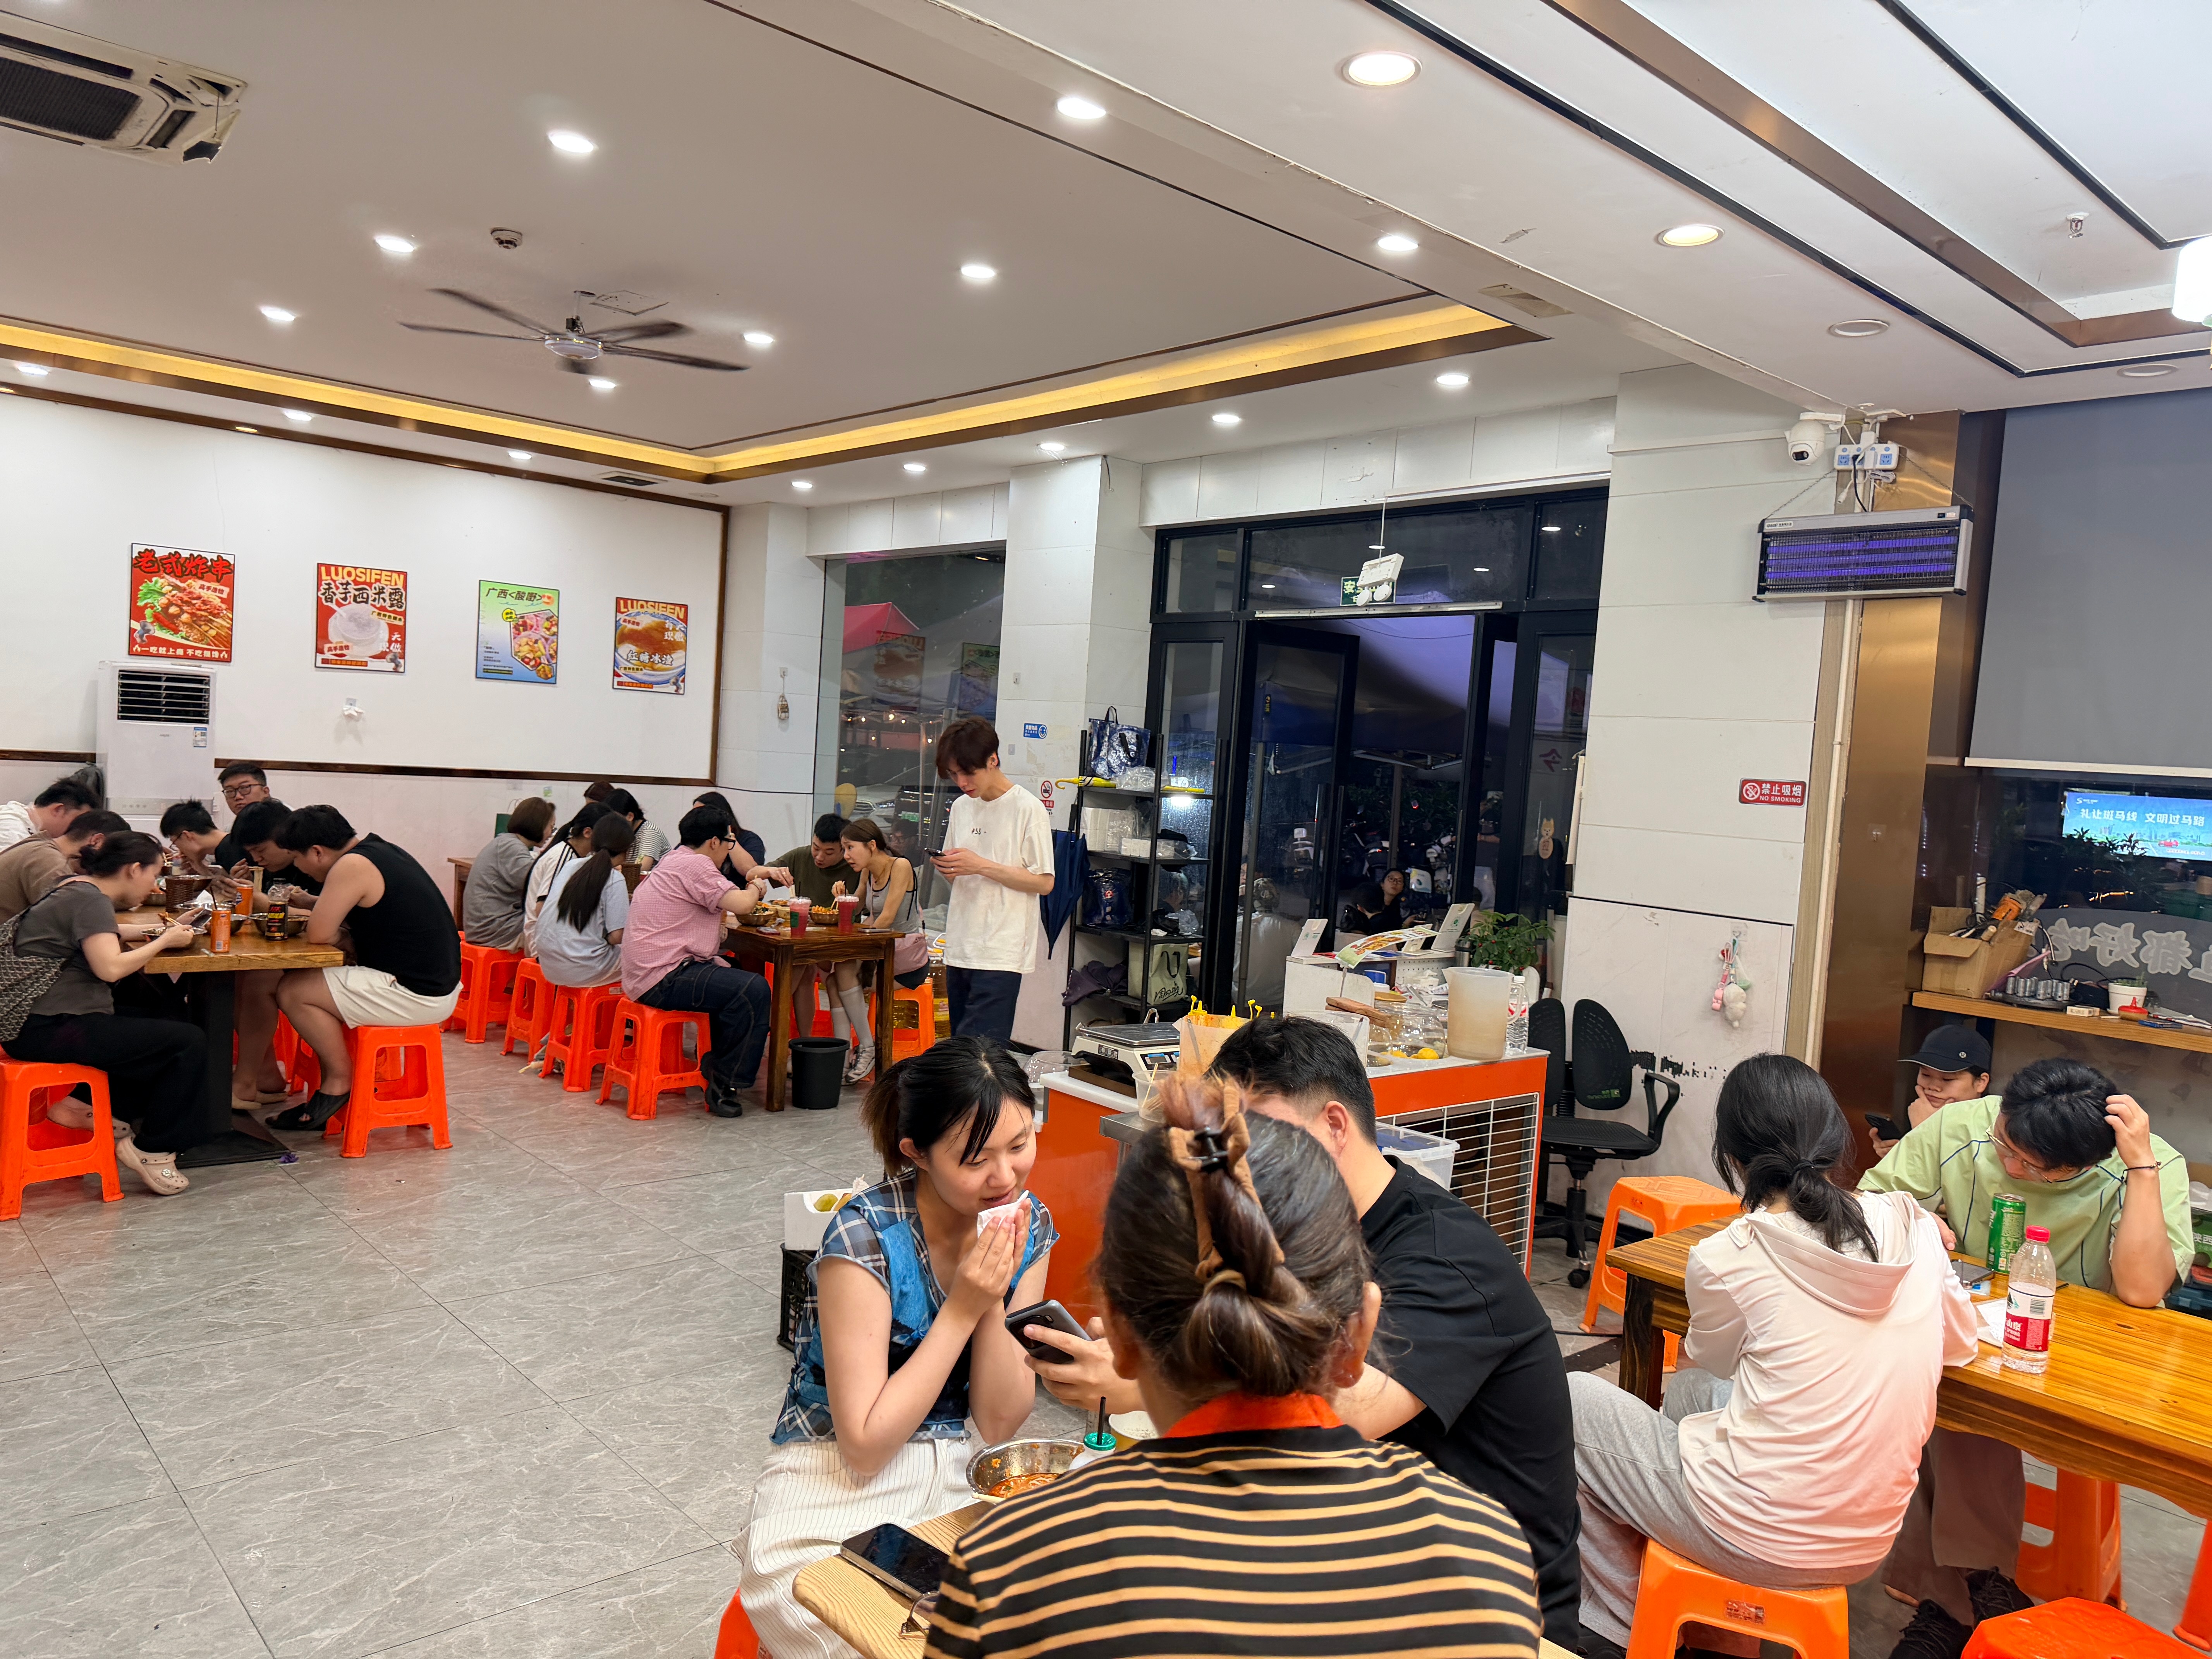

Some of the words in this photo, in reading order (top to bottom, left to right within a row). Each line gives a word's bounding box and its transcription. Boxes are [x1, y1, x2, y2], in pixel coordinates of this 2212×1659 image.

[133, 548, 233, 582] 老式炸串
[321, 567, 404, 587] LUOSIFEN
[320, 580, 405, 610] 香芋西米露
[620, 600, 685, 619] LUOSIFEN
[1762, 783, 1802, 797] 禁止吸烟
[2081, 809, 2137, 822] 礼让斑马线
[2145, 812, 2205, 827] 文明过马路
[2006, 1317, 2021, 1331] 山泉
